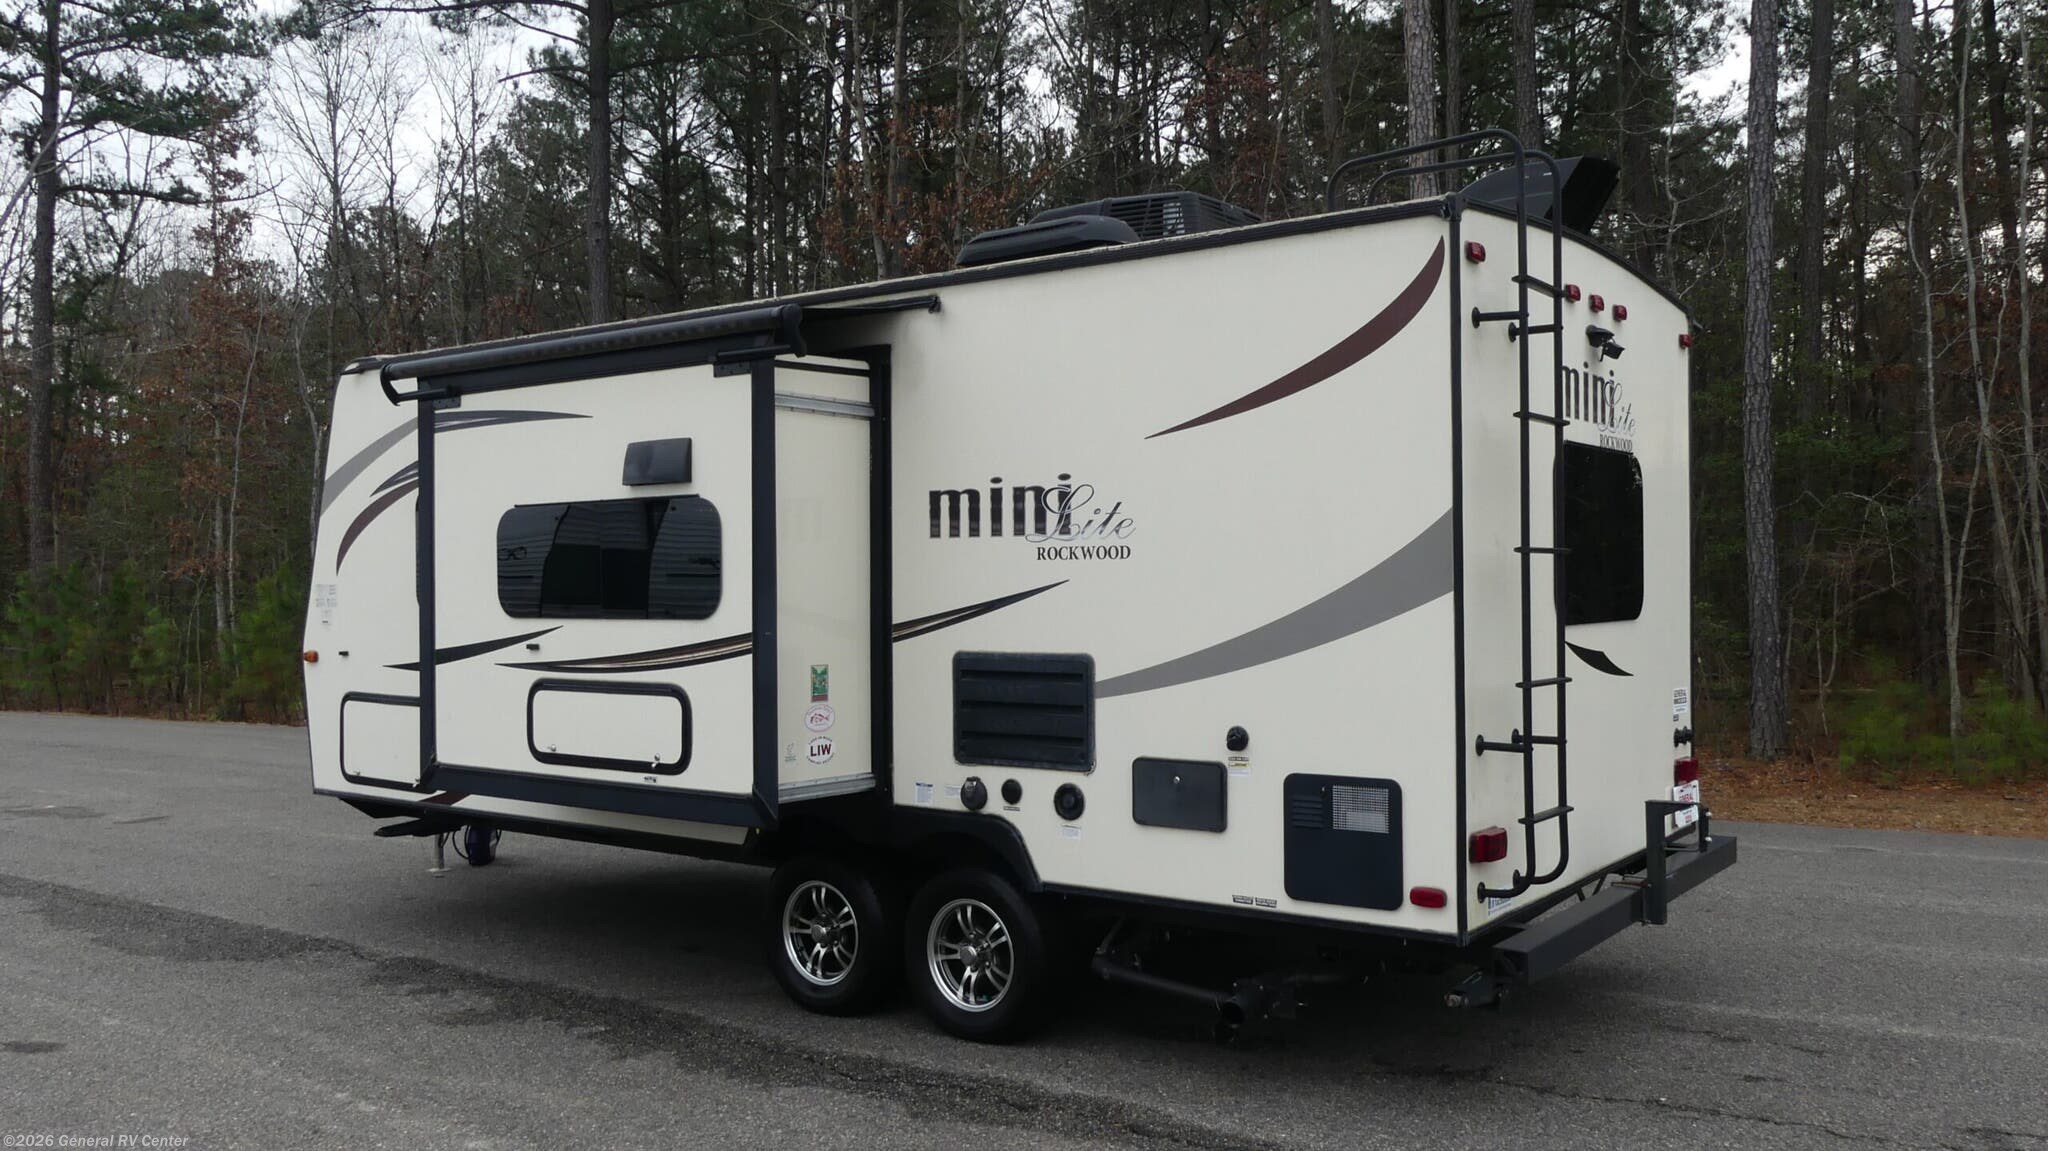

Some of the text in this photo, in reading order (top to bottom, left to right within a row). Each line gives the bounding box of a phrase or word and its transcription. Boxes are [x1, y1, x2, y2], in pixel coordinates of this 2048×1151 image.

[1597, 383, 1637, 437] Lite
[1600, 434, 1633, 452] ROCKWOOD
[929, 473, 1136, 543] mini Lite
[1037, 545, 1131, 561] ROCKWOOD
[810, 744, 832, 757] LIW
